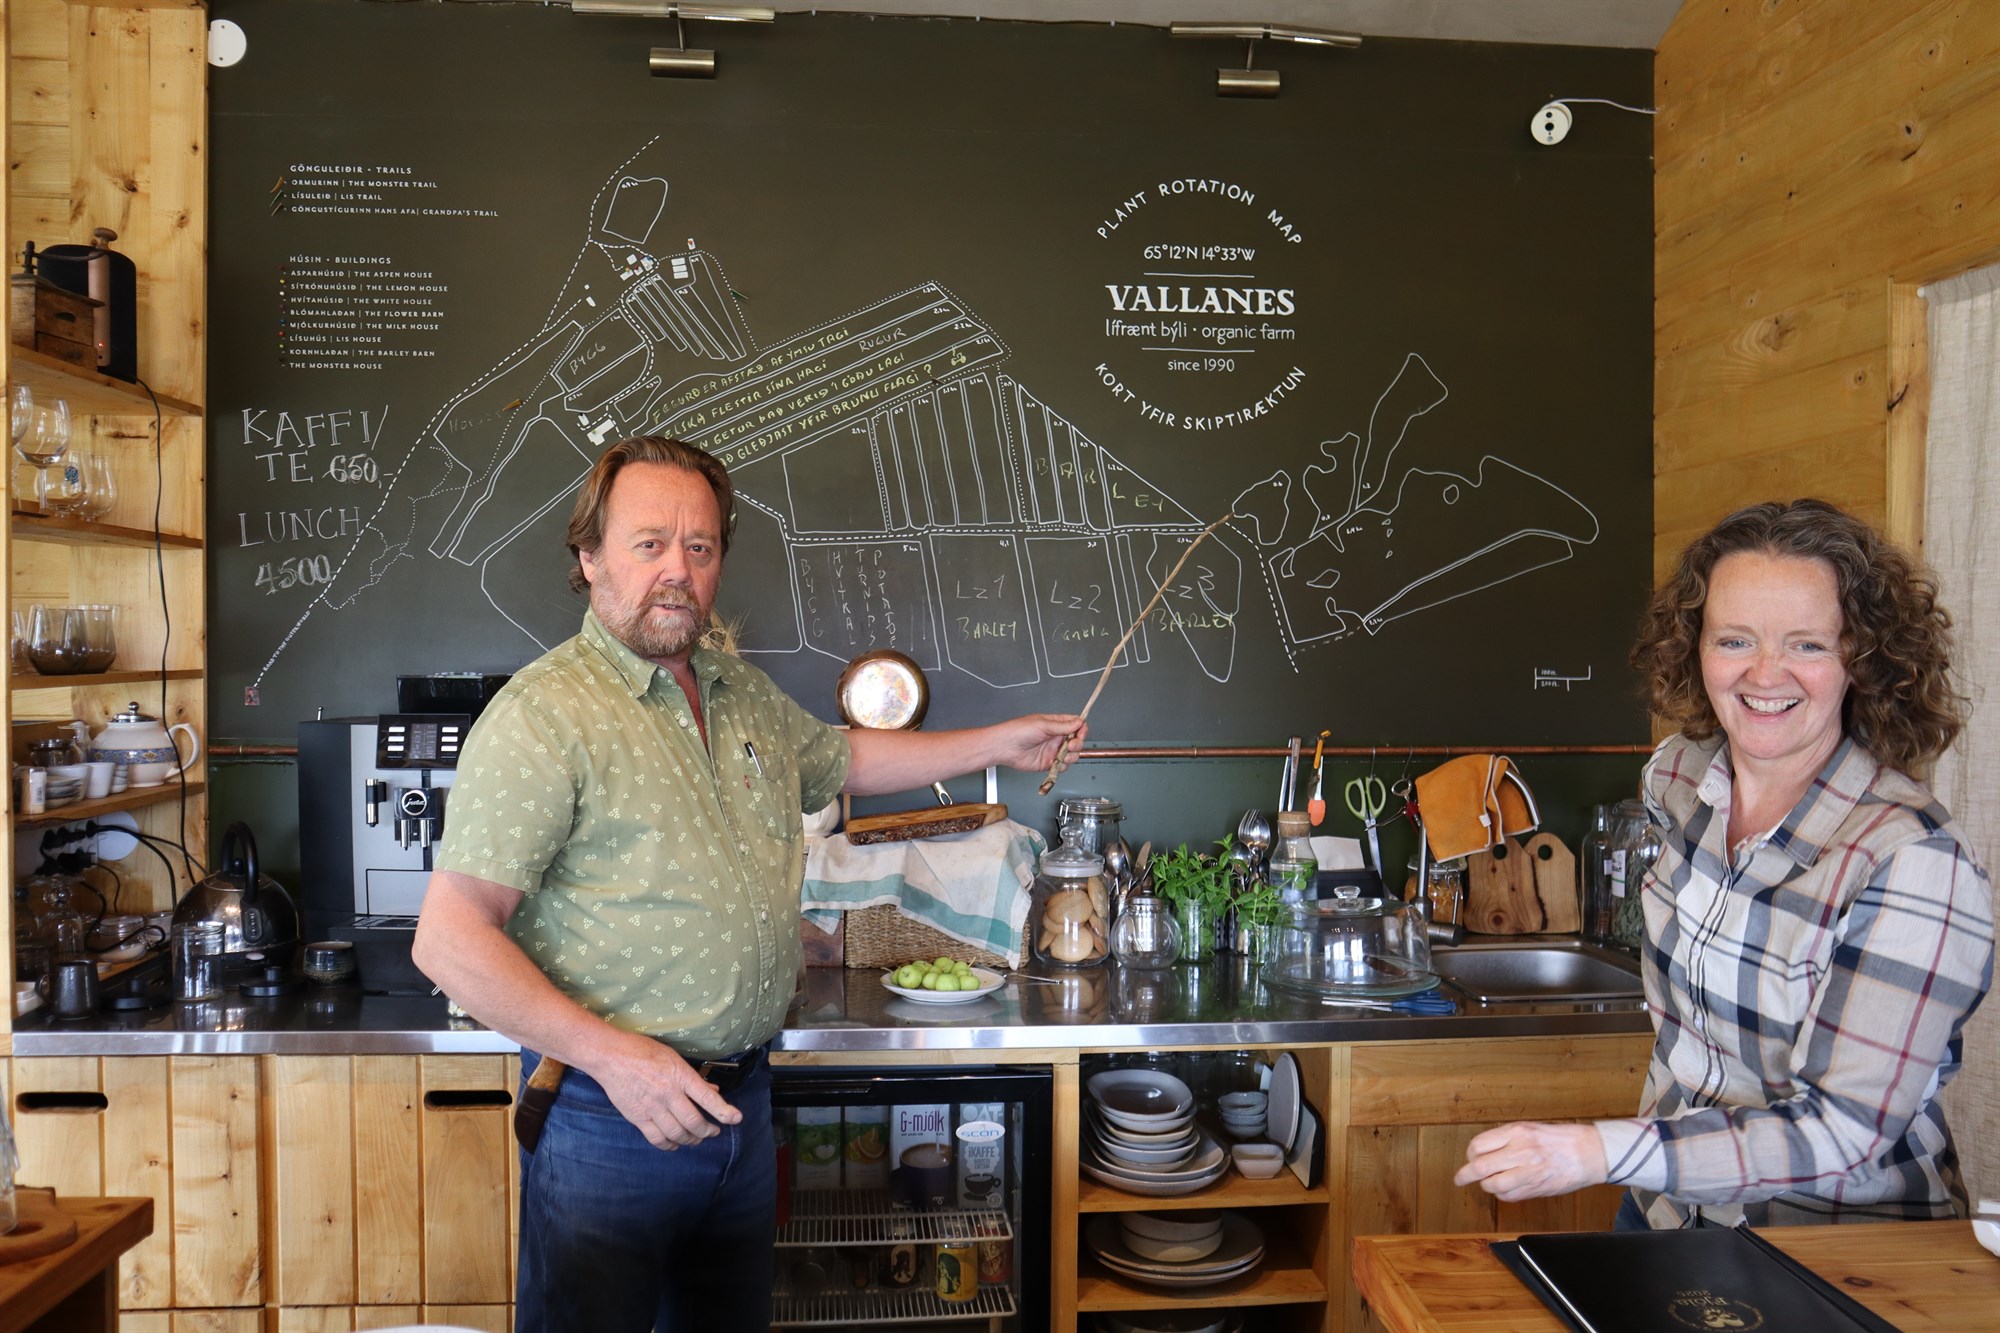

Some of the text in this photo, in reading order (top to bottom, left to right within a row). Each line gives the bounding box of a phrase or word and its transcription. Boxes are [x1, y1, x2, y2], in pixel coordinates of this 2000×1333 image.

[375, 166, 412, 174] TRAILS
[422, 208, 471, 216] GRANDPA'S
[1097, 179, 1302, 244] PLANT ROTATION MAP
[289, 254, 392, 264] HÚSIN BUILDINGS
[1105, 284, 1296, 316] VALLANES
[1105, 319, 1295, 345] lífrænt býli organic farm
[770, 356, 784, 367] AF
[1168, 358, 1235, 372] since 1990
[1095, 362, 1306, 431] KORT YFIR SKIPTIRÆKTUN
[713, 421, 756, 445] GETUR
[255, 450, 314, 483] TE
[238, 506, 362, 548] LUNCH
[901, 1110, 944, 1132] G-mjólk
[961, 1129, 999, 1137] scan
